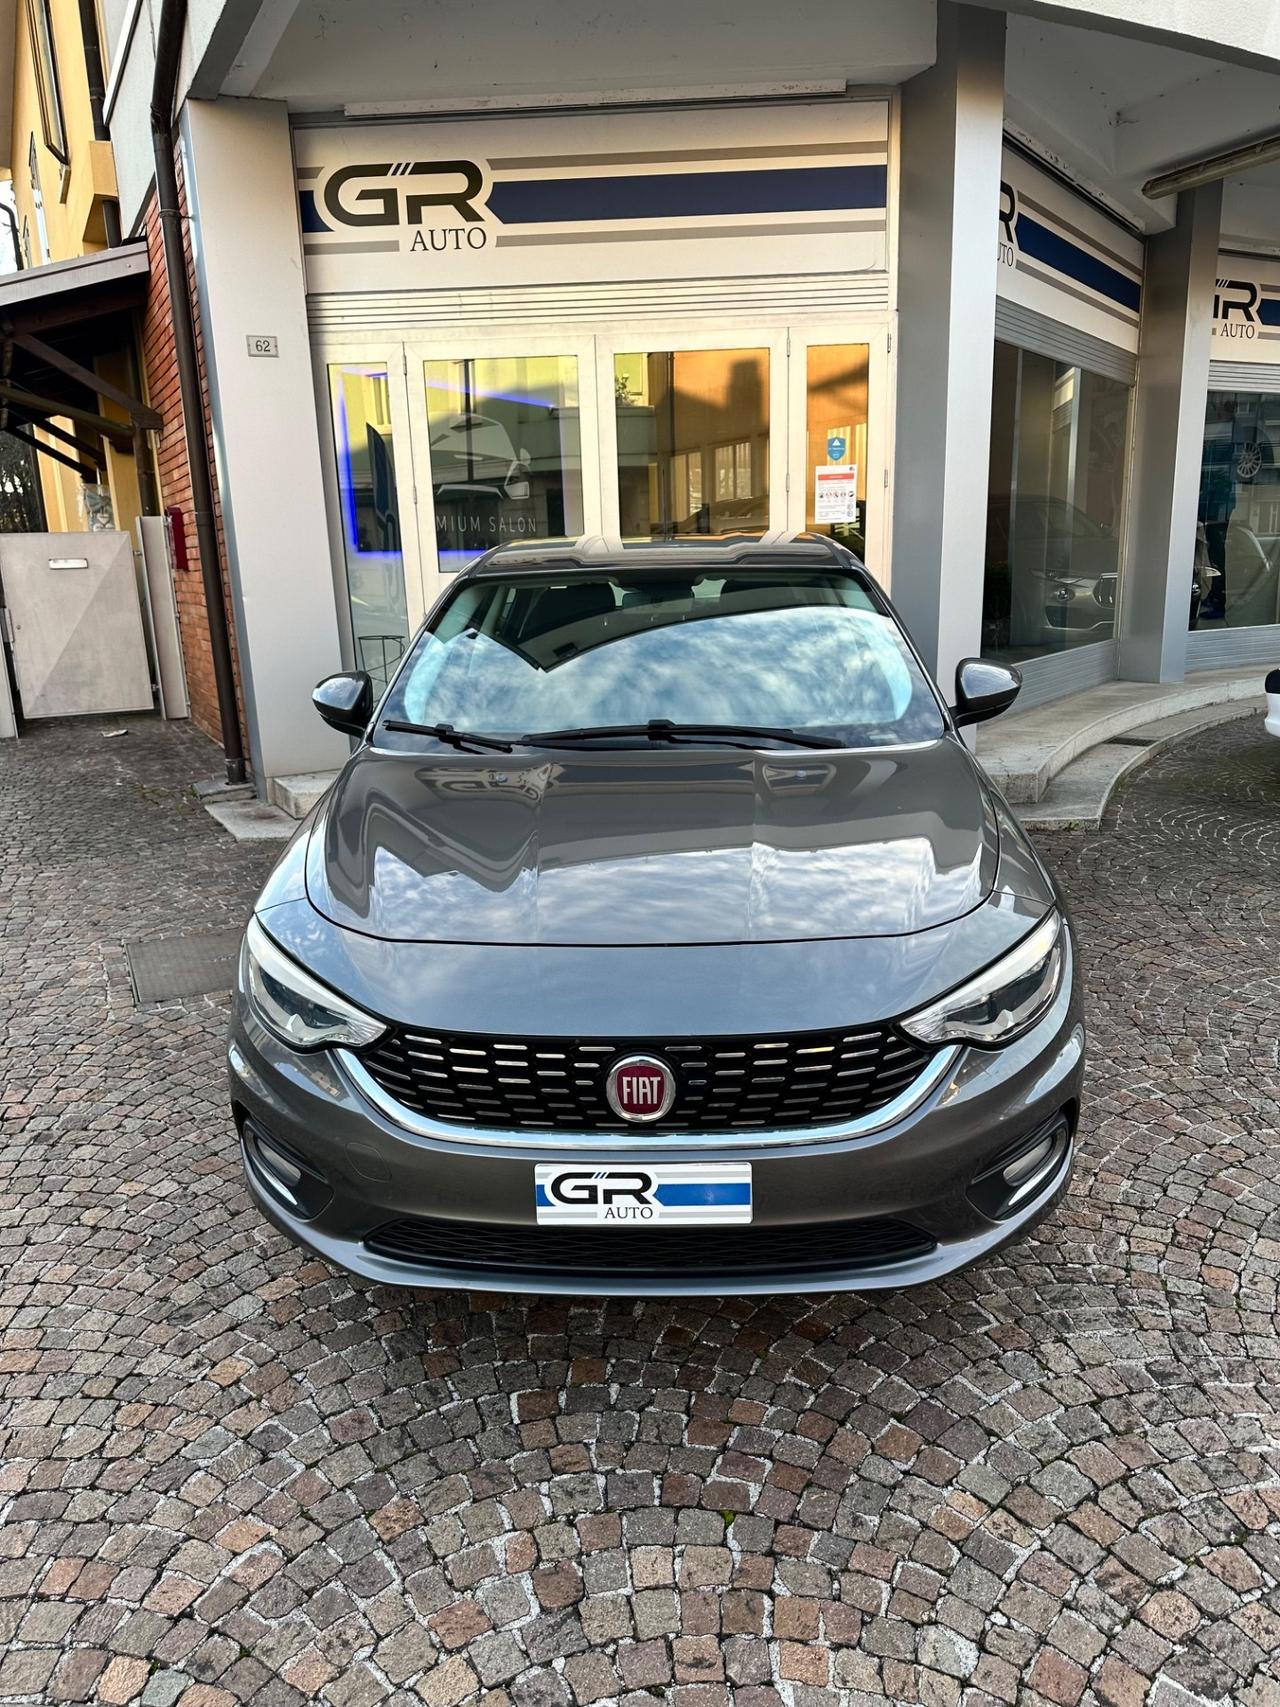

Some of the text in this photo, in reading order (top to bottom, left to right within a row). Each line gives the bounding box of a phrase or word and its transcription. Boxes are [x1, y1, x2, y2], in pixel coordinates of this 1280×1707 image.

[324, 160, 485, 227] GR
[999, 180, 1016, 244] R
[410, 227, 487, 251] AUTO
[997, 242, 1014, 267] TO
[1213, 279, 1255, 322] R
[1220, 323, 1255, 339] AUTO
[255, 340, 271, 352] 62
[436, 515, 536, 533] MIUM SALON
[622, 1076, 661, 1105] FIAT
[551, 1171, 653, 1204] GR
[604, 1207, 654, 1219] AUTO
